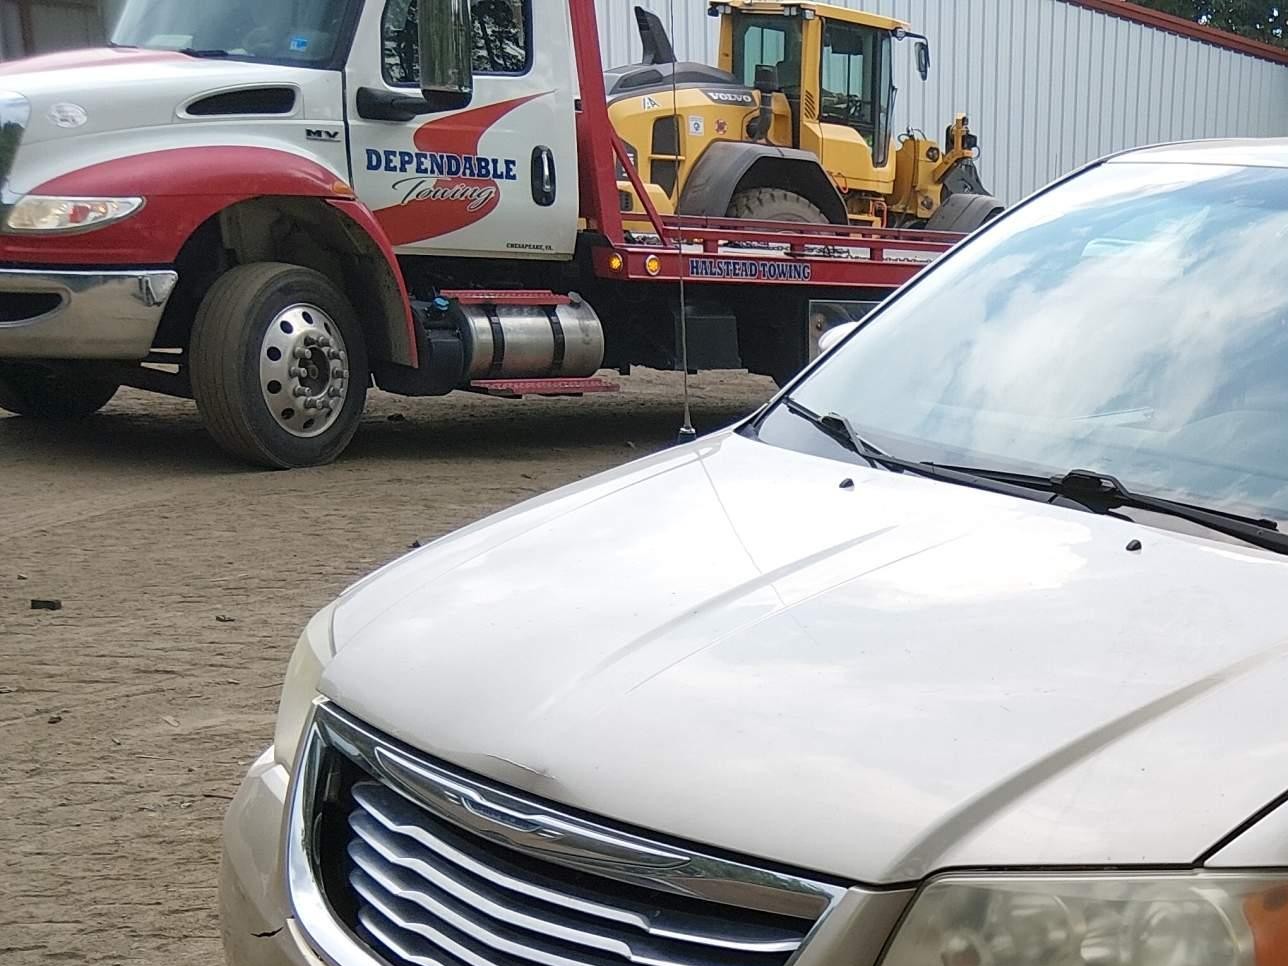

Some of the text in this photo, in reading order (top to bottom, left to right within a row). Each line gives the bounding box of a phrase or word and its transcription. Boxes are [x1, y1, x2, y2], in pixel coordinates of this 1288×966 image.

[707, 91, 752, 103] VOLVO
[306, 129, 339, 138] MV
[365, 148, 518, 181] DEPENDABLE
[391, 176, 496, 210] Towing
[690, 258, 812, 280] HALSTEAD TOWING
